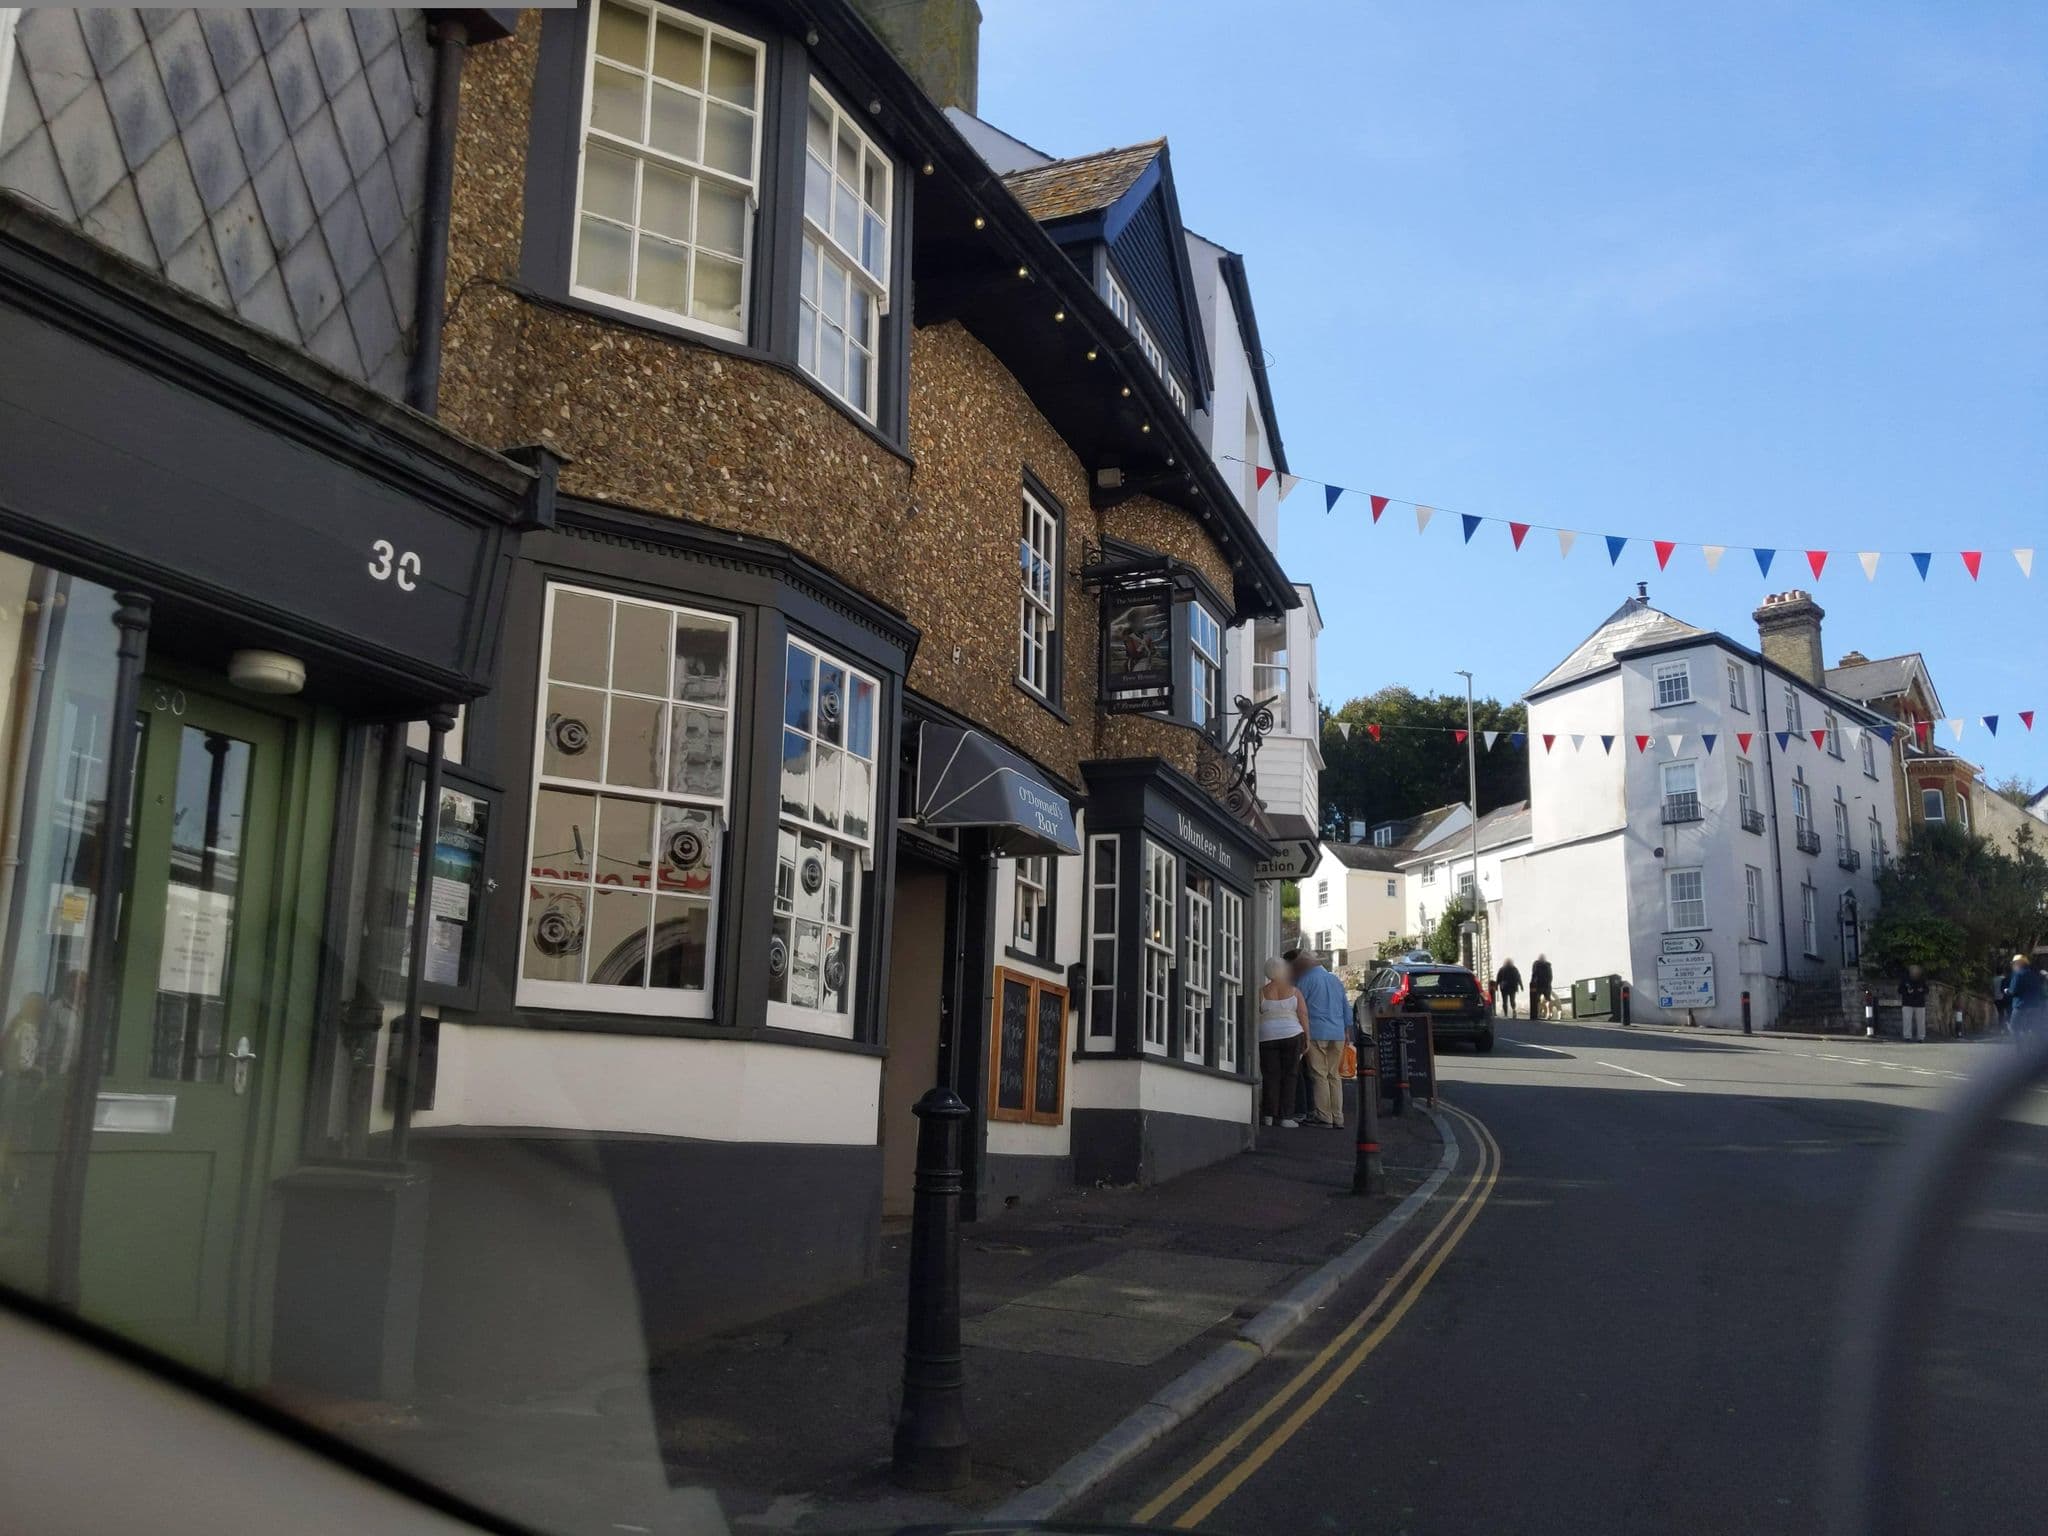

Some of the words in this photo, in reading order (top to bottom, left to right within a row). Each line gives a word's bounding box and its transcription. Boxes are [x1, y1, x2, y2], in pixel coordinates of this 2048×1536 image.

[368, 539, 421, 592] 30
[1019, 786, 1063, 820] O'Donnell's
[1035, 811, 1058, 836] Bar
[1177, 813, 1217, 858] Volunteer
[1219, 842, 1231, 869] Inn
[1256, 860, 1294, 873] tation
